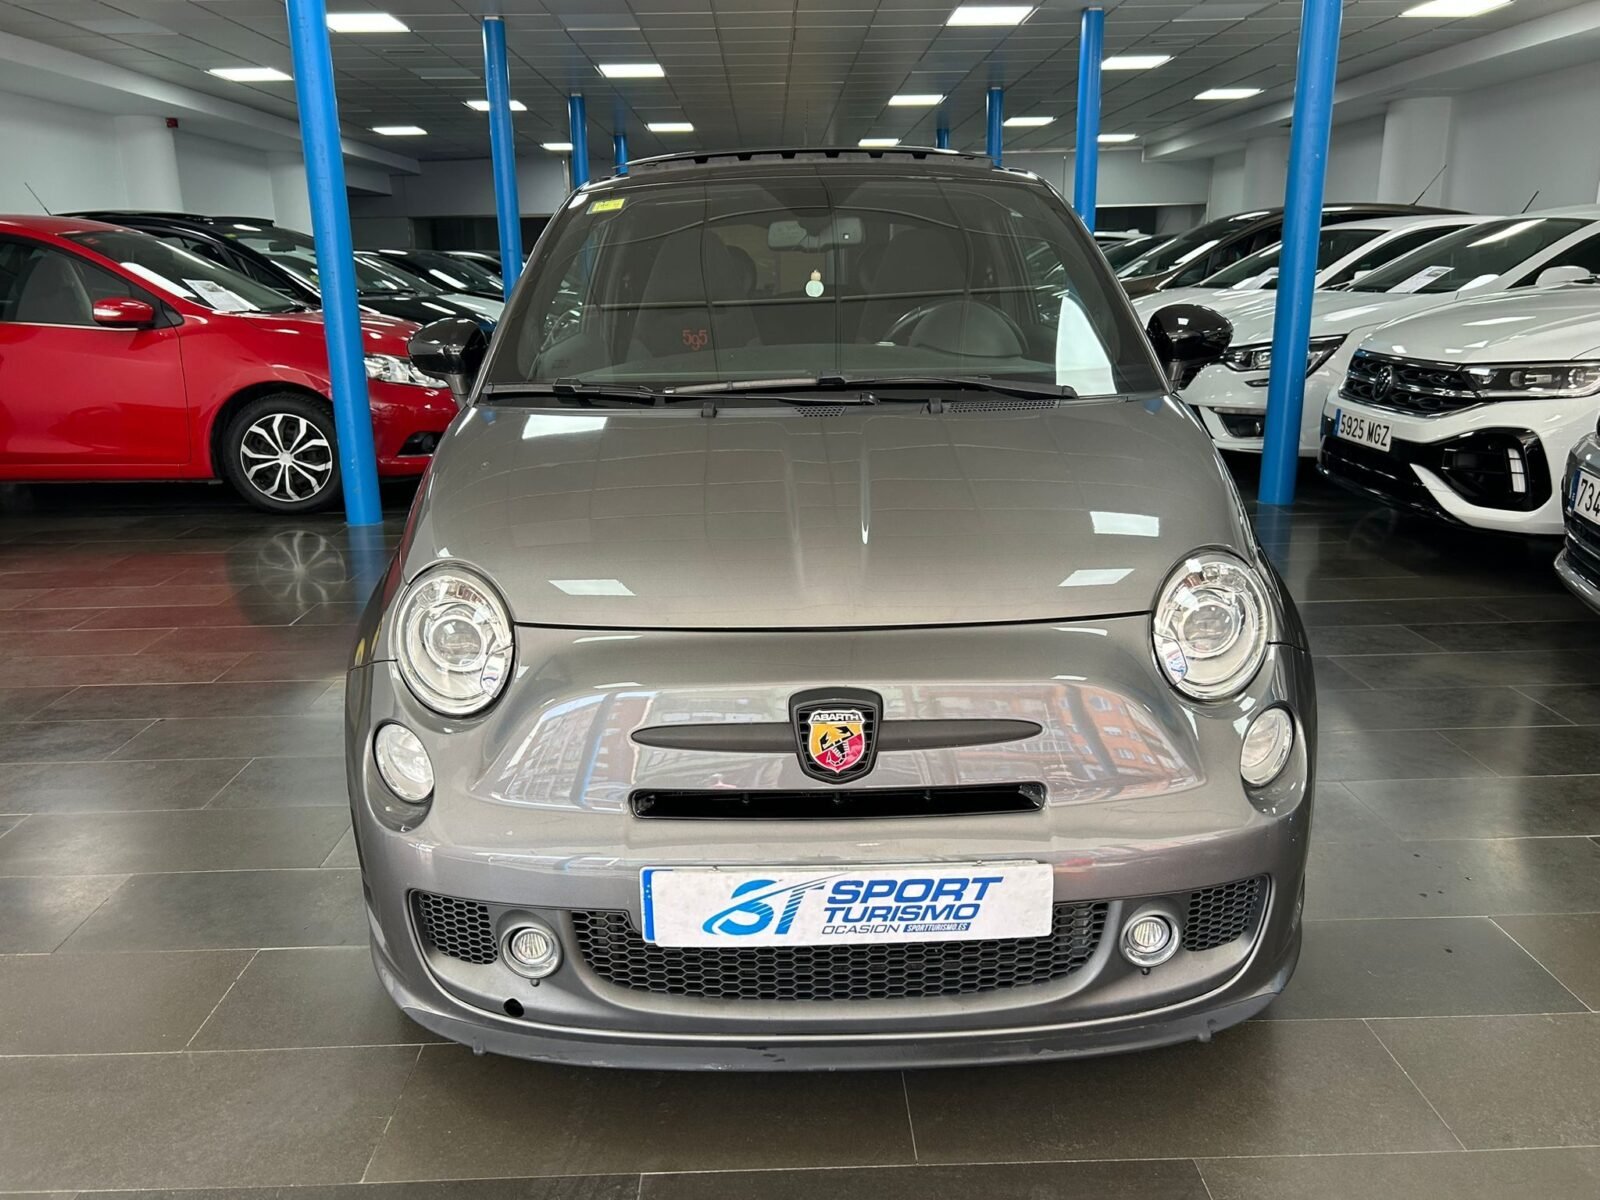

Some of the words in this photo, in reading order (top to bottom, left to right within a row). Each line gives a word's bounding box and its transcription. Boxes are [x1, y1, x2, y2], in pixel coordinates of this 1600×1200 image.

[1340, 414, 1365, 440] 5925
[1366, 421, 1390, 447] MGZ
[813, 713, 859, 721] ABARTH
[827, 876, 1004, 905] SPORT
[823, 903, 981, 924] TURISMO
[821, 924, 900, 935] OCASION
[906, 922, 970, 933] SPORTTURISMO.ES
